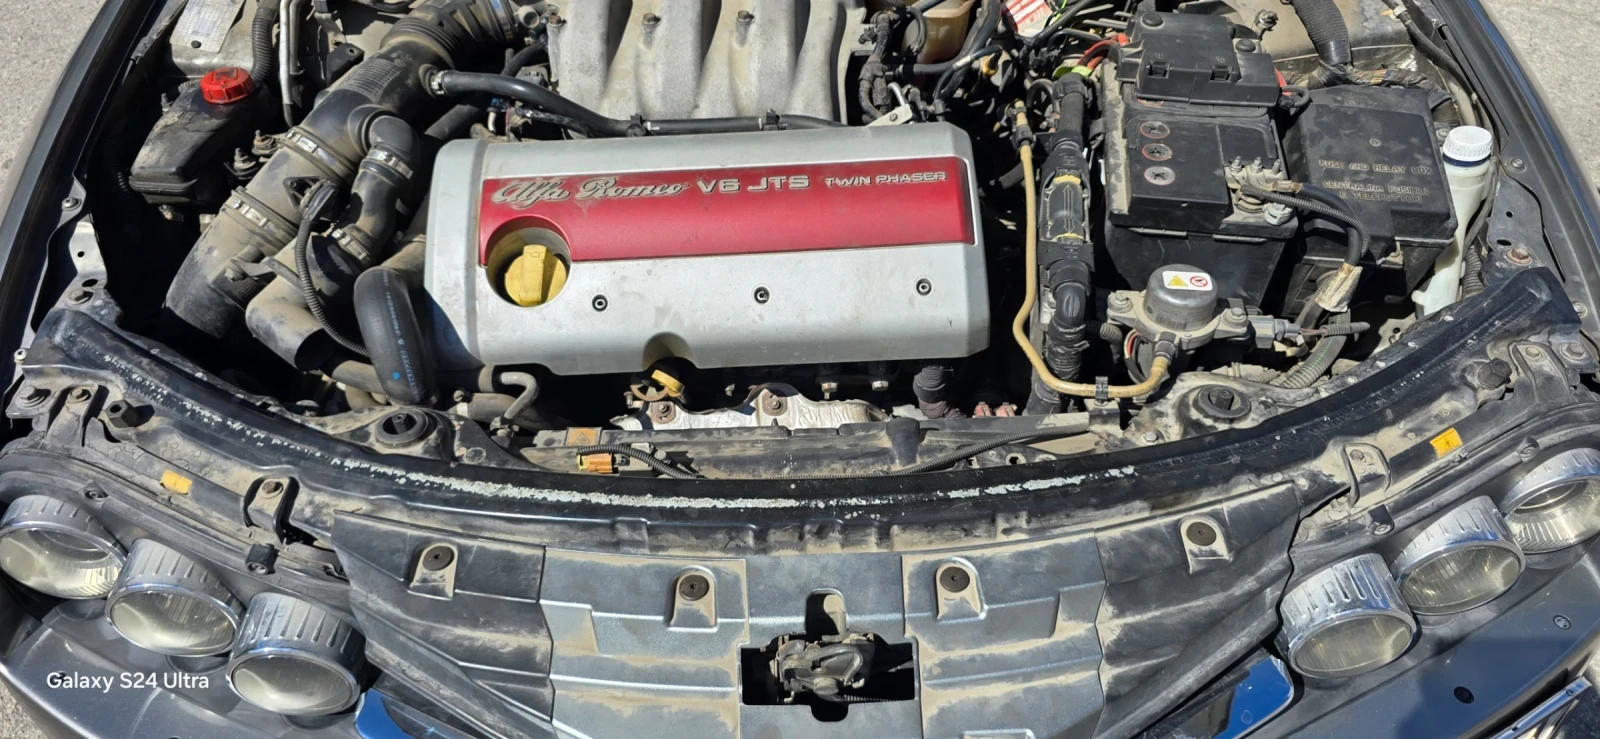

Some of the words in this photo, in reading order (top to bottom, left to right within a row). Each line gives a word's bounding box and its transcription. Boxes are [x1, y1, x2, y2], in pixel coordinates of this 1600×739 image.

[1319, 160, 1345, 169] FUSE
[1349, 163, 1370, 171] AND
[1373, 164, 1406, 173] RELAY
[1410, 165, 1433, 175] BOX
[492, 178, 572, 210] Alfa
[575, 177, 690, 199] Romeo
[697, 178, 741, 194] V6
[747, 175, 810, 192] JTS
[825, 176, 872, 188] TWIN
[875, 171, 947, 184] PHASER
[1322, 180, 1384, 193] CENTRALINA
[1388, 185, 1429, 195] FUSIBILI
[1340, 191, 1348, 199] E
